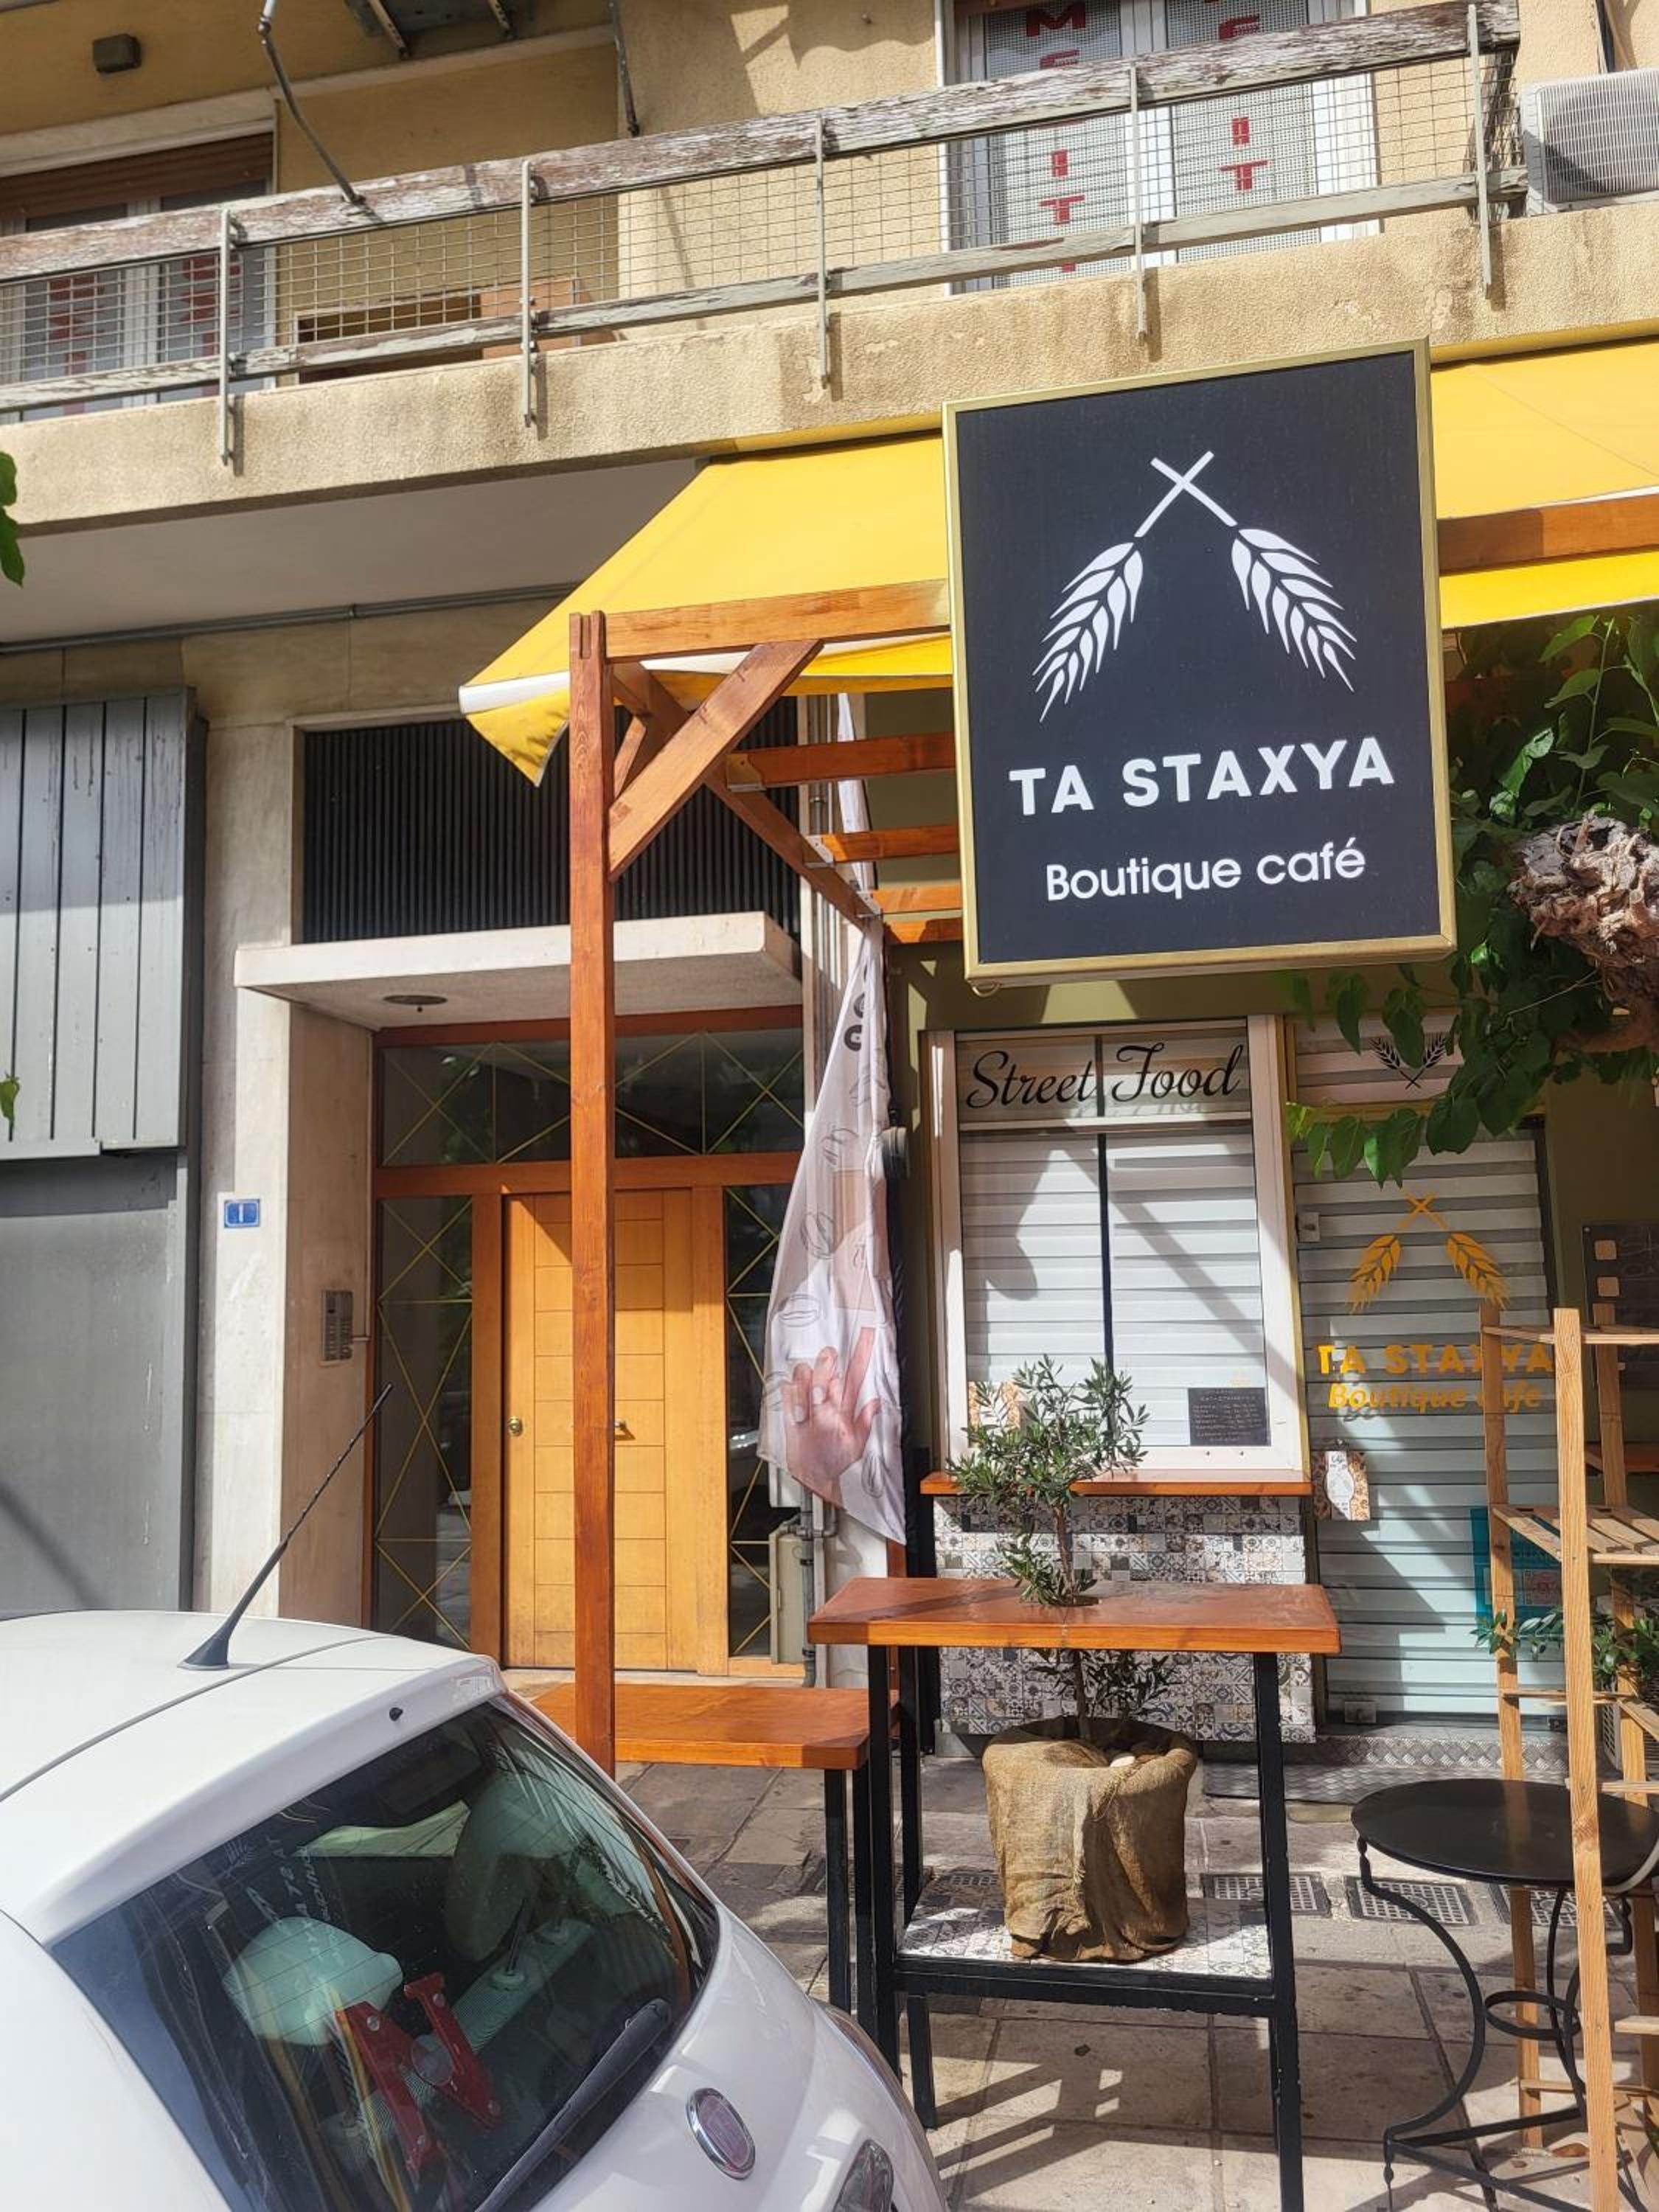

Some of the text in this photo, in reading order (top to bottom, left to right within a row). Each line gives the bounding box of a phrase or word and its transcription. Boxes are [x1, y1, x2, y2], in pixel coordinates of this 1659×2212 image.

[1009, 737, 1395, 816] TA STAXYA
[1046, 837, 1366, 902] Boutique café
[966, 1041, 1244, 1109] Street Food
[1318, 1343, 1367, 1375] TA
